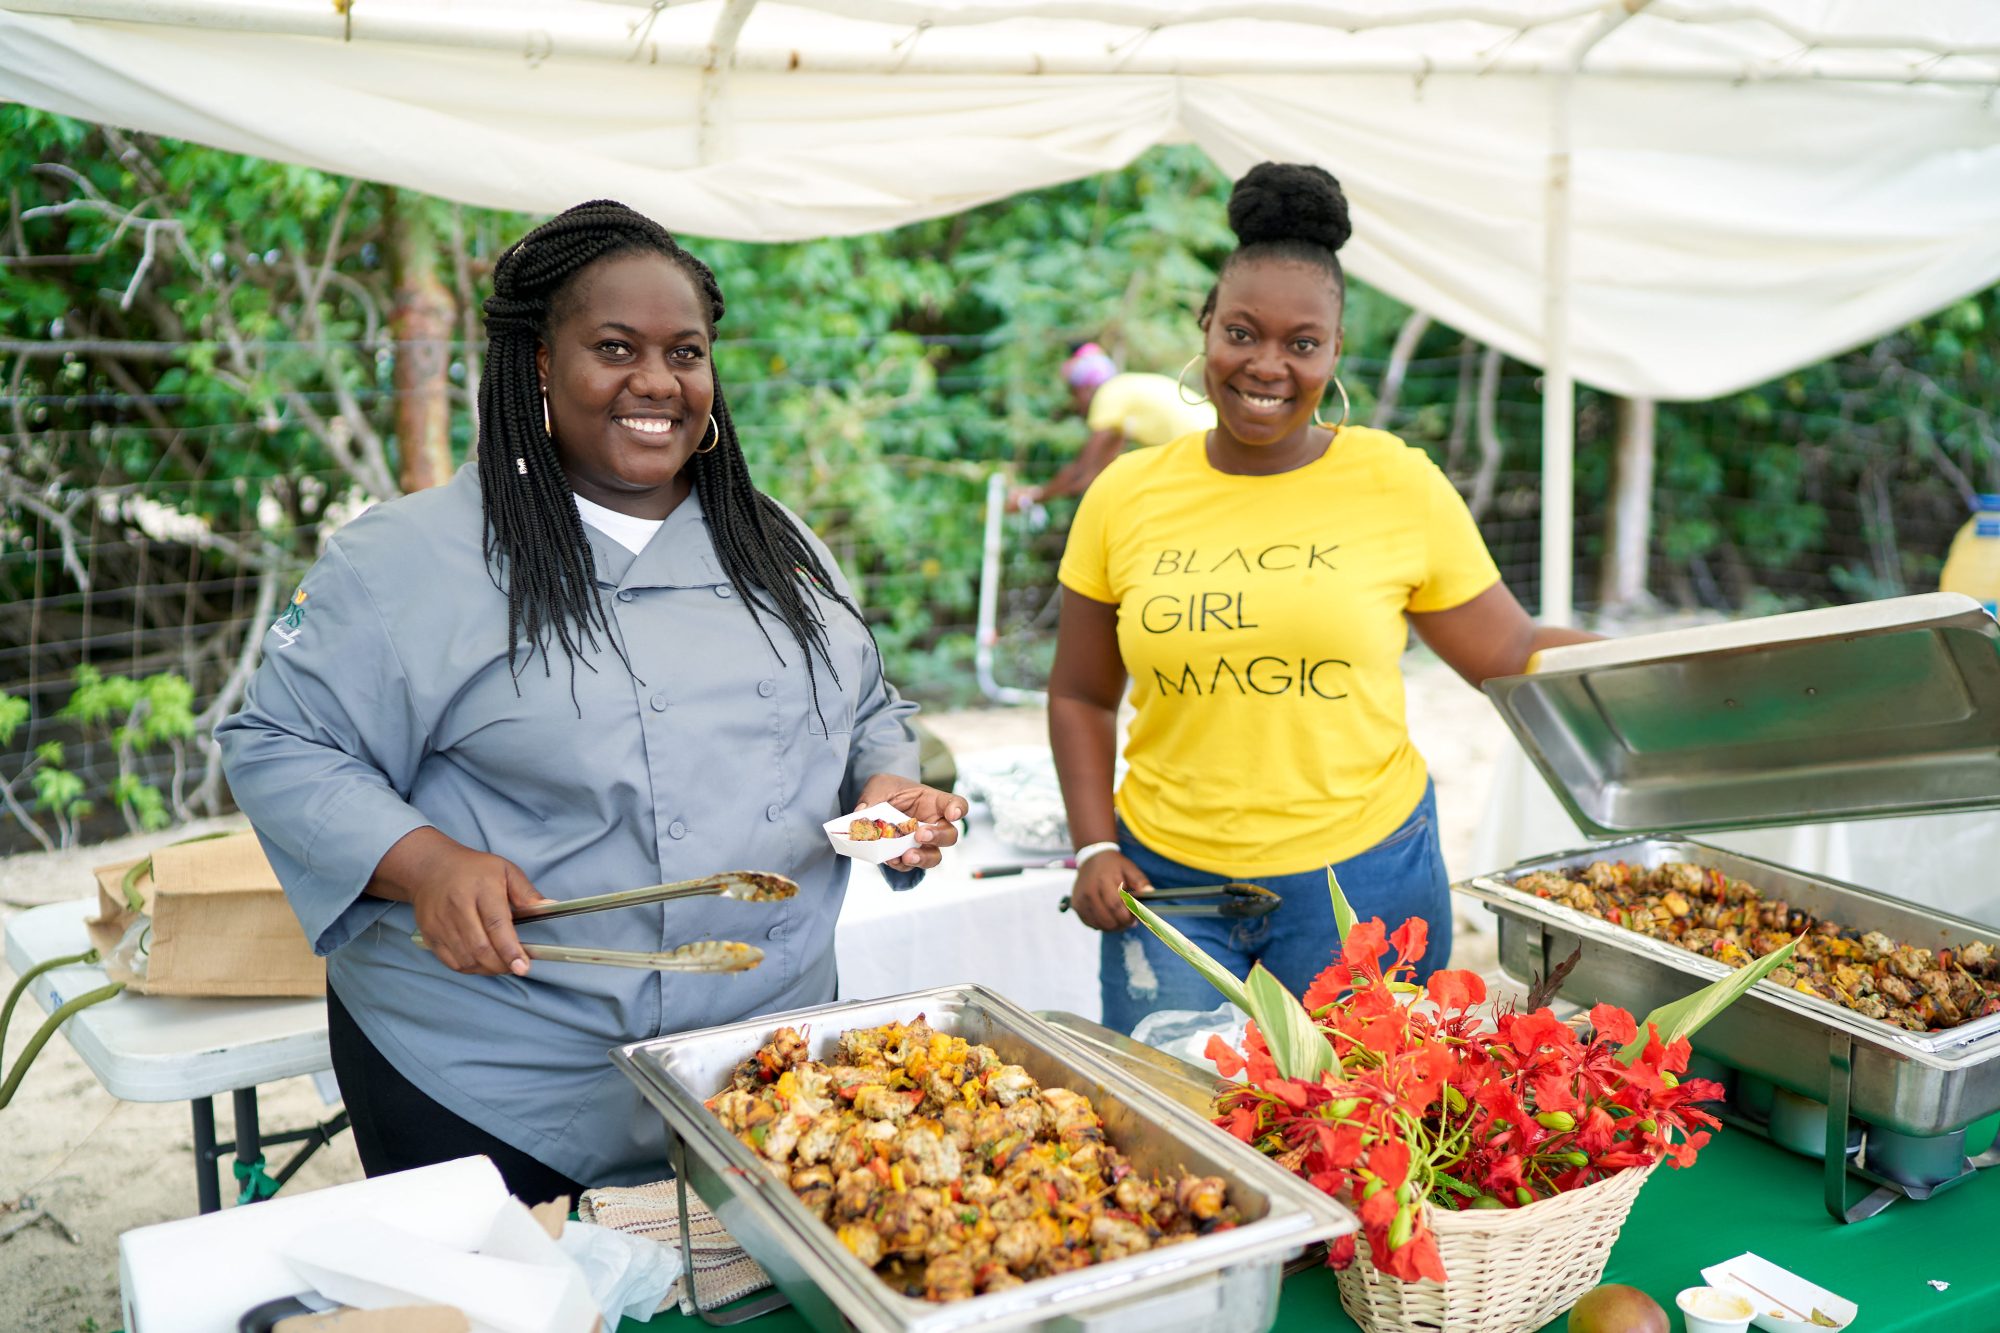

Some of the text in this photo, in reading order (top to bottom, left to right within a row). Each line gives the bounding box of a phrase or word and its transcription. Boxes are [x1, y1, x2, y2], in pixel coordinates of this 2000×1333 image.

[1153, 544, 1339, 576] BLACK
[1141, 591, 1258, 634] GIRL
[1153, 656, 1351, 699] MAGIC
